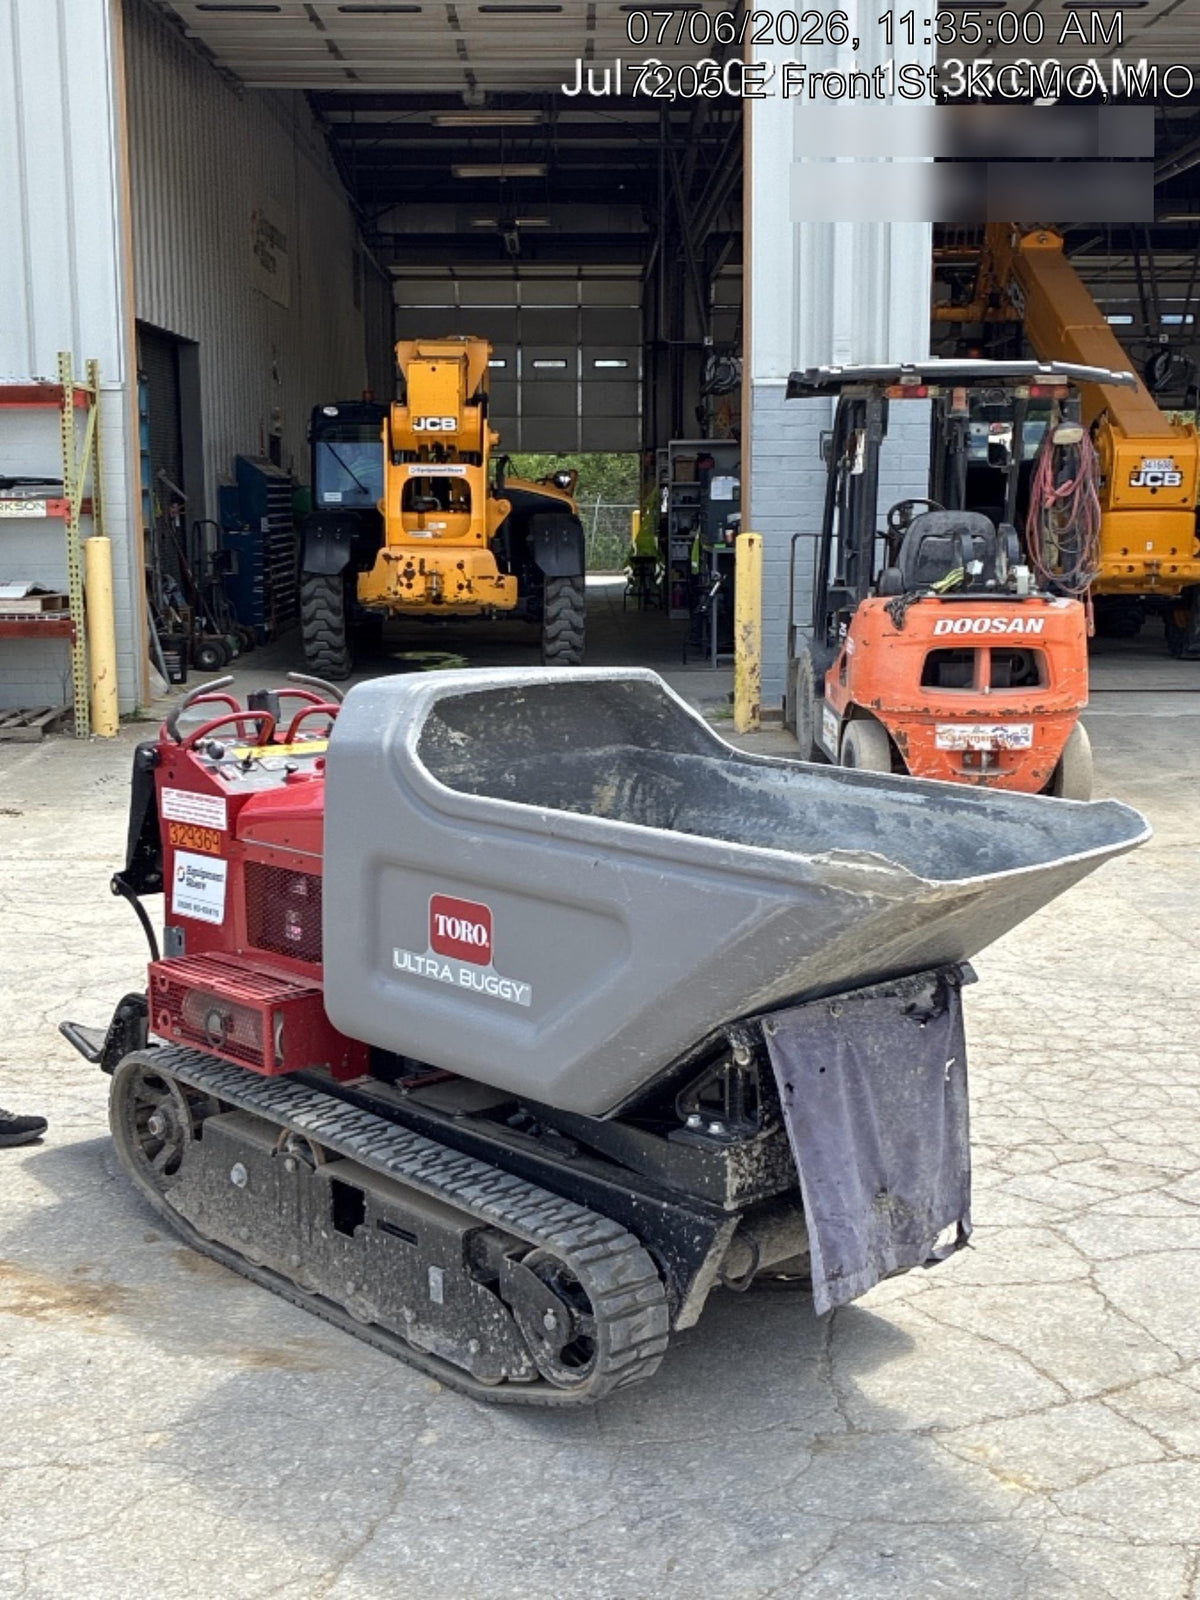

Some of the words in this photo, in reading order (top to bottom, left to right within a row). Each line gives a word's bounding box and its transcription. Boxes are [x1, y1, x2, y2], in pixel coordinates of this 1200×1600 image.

[412, 417, 457, 431] JCB
[1129, 471, 1182, 487] JCB
[933, 617, 1045, 635] DOOSAN
[393, 950, 454, 982] ULTRA
[459, 968, 526, 1002] BUGGY
